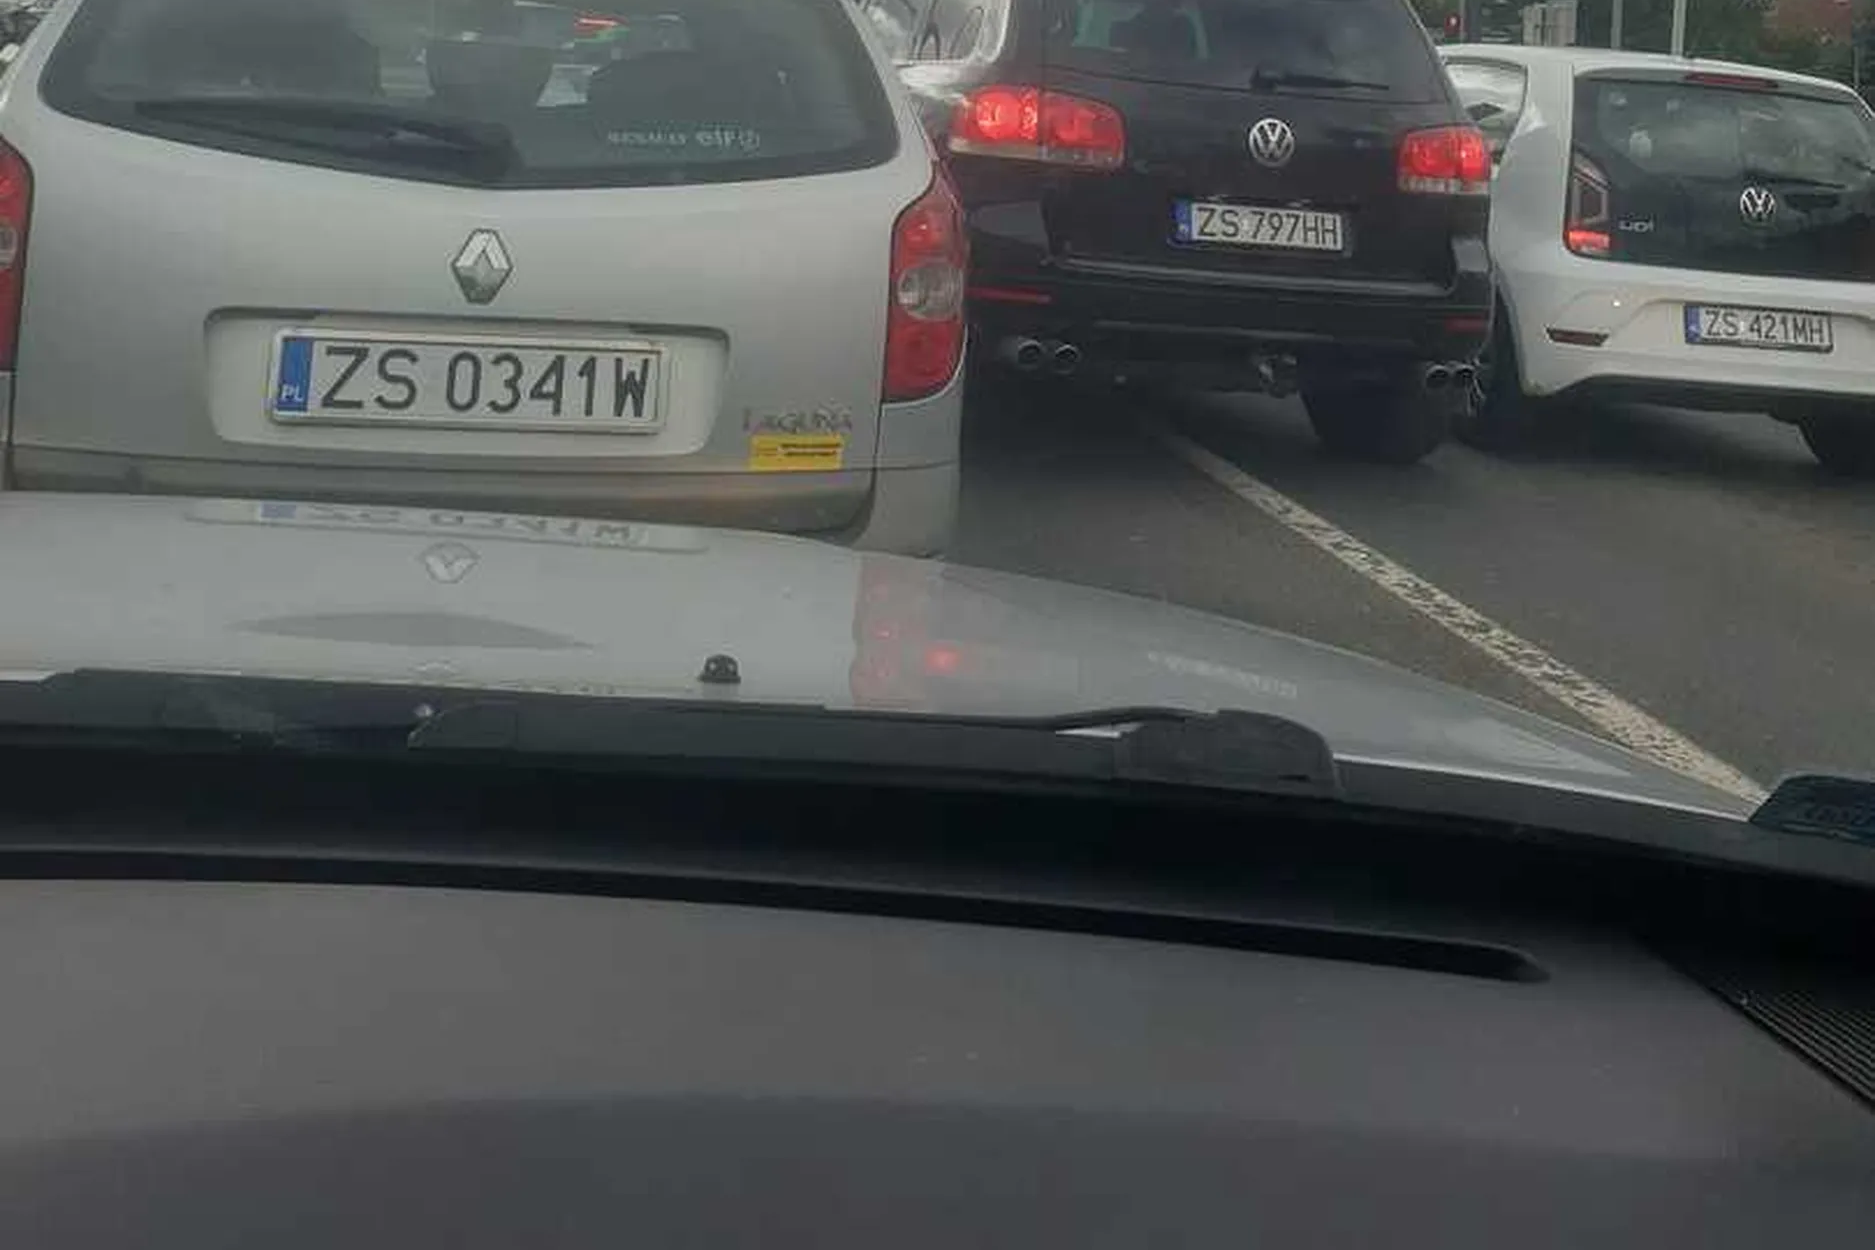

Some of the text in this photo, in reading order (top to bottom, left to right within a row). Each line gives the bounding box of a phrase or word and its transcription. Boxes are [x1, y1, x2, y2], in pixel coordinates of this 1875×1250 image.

[1196, 207, 1240, 238] ZS
[1251, 210, 1338, 245] 797HH
[1704, 309, 1740, 337] ZS
[1749, 313, 1824, 343] 421MH
[281, 382, 304, 403] PL
[321, 345, 651, 418] ZS 0341W
